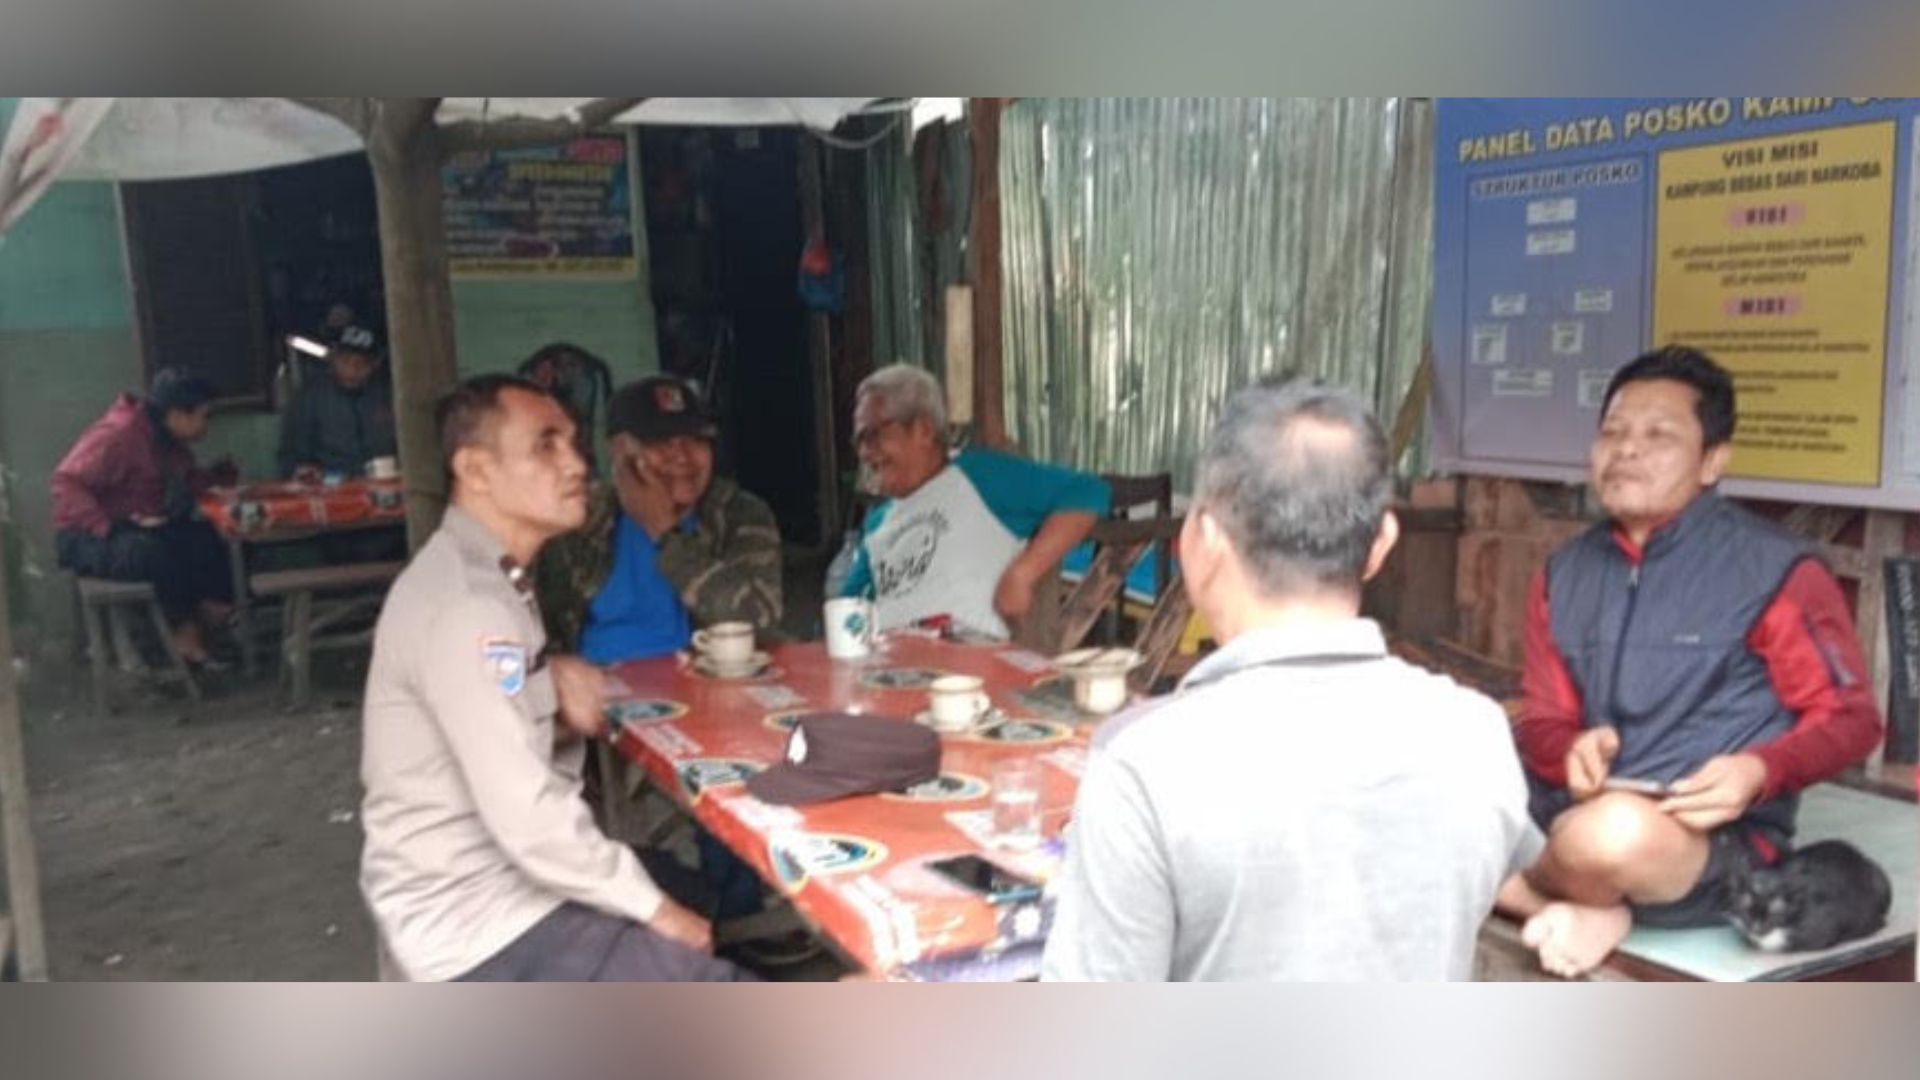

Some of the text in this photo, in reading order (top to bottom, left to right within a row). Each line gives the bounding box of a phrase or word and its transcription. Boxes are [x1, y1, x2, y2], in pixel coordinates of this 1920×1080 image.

[1459, 129, 1535, 163] PANEL
[1546, 118, 1613, 151] DATA
[1624, 98, 1731, 139] POSKO
[1722, 141, 1818, 168] VISI MISI
[1475, 162, 1639, 196] STRUKTUR POSKO
[1665, 161, 1882, 199] KAMPUNG BEBAS DARI NARKOBA
[1739, 297, 1786, 315] MISI
